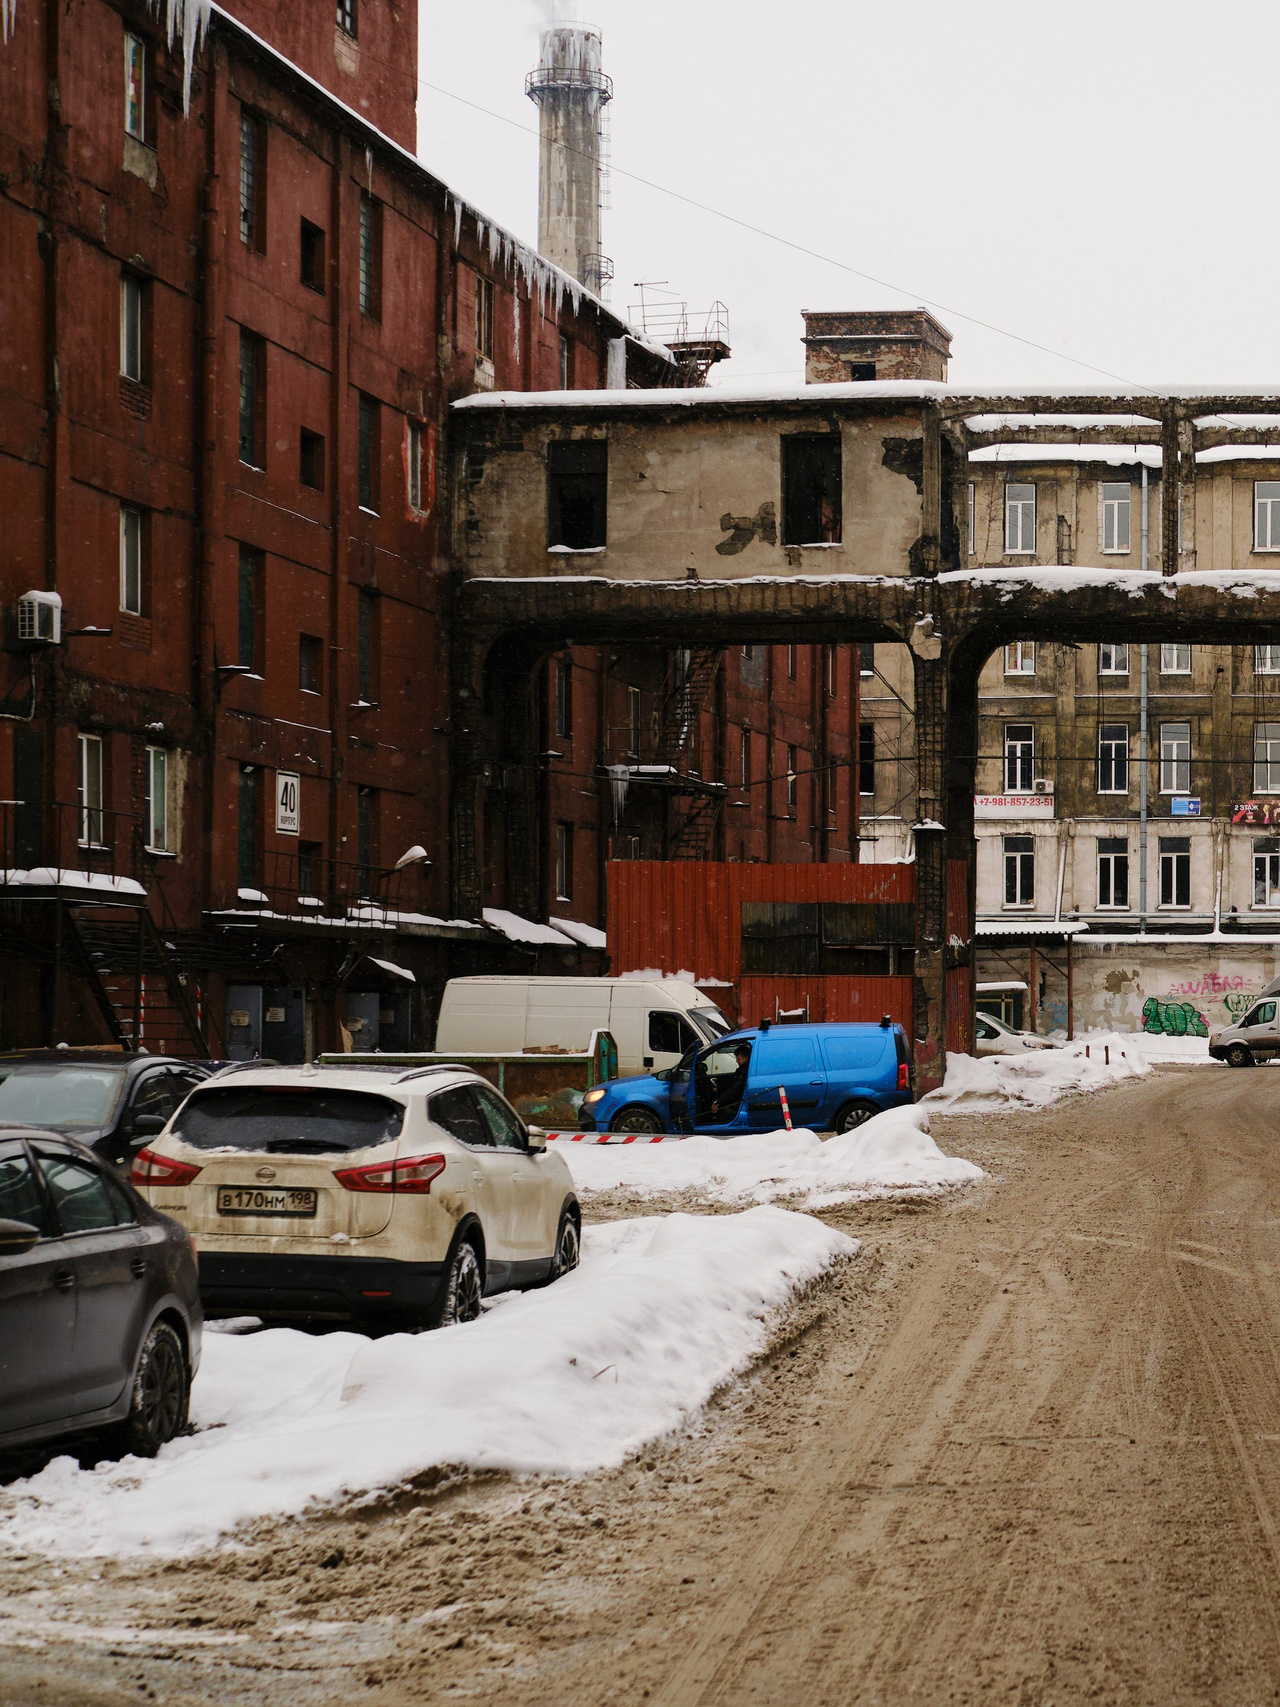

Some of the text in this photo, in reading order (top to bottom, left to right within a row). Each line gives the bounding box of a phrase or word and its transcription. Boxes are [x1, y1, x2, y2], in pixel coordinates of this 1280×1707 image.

[280, 781, 296, 813] 40
[979, 797, 1053, 806] +7-981-857-23-51
[288, 1192, 311, 1204] 198
